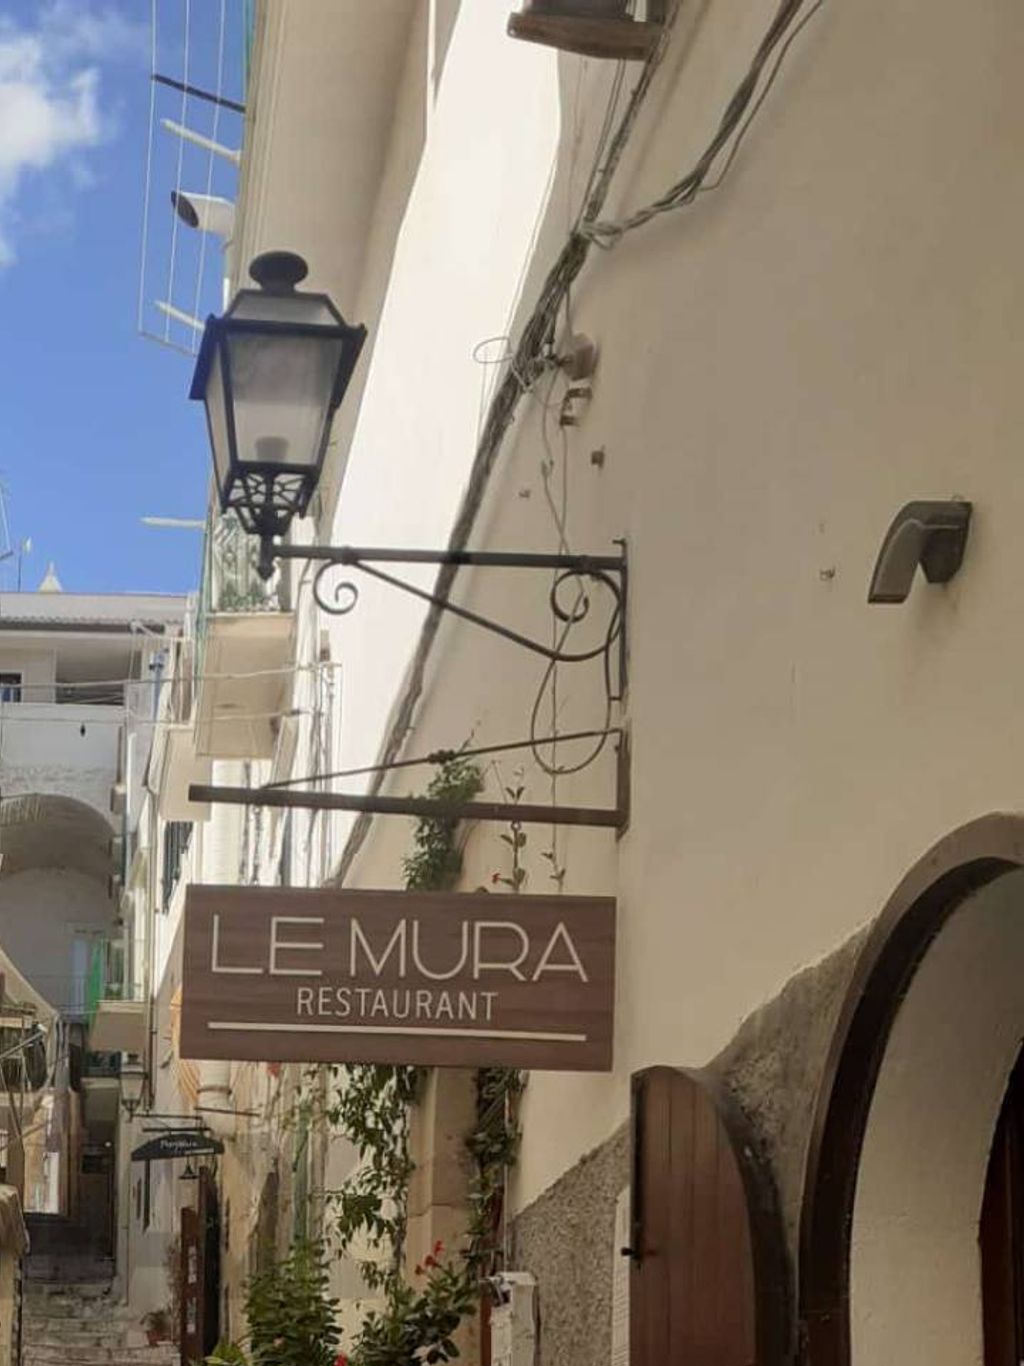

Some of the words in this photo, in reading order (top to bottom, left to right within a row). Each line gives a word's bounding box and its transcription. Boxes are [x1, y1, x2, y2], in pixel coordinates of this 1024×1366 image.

[210, 914, 325, 977] LE
[349, 917, 589, 983] MURA
[296, 986, 499, 1021] RESTAURANT
